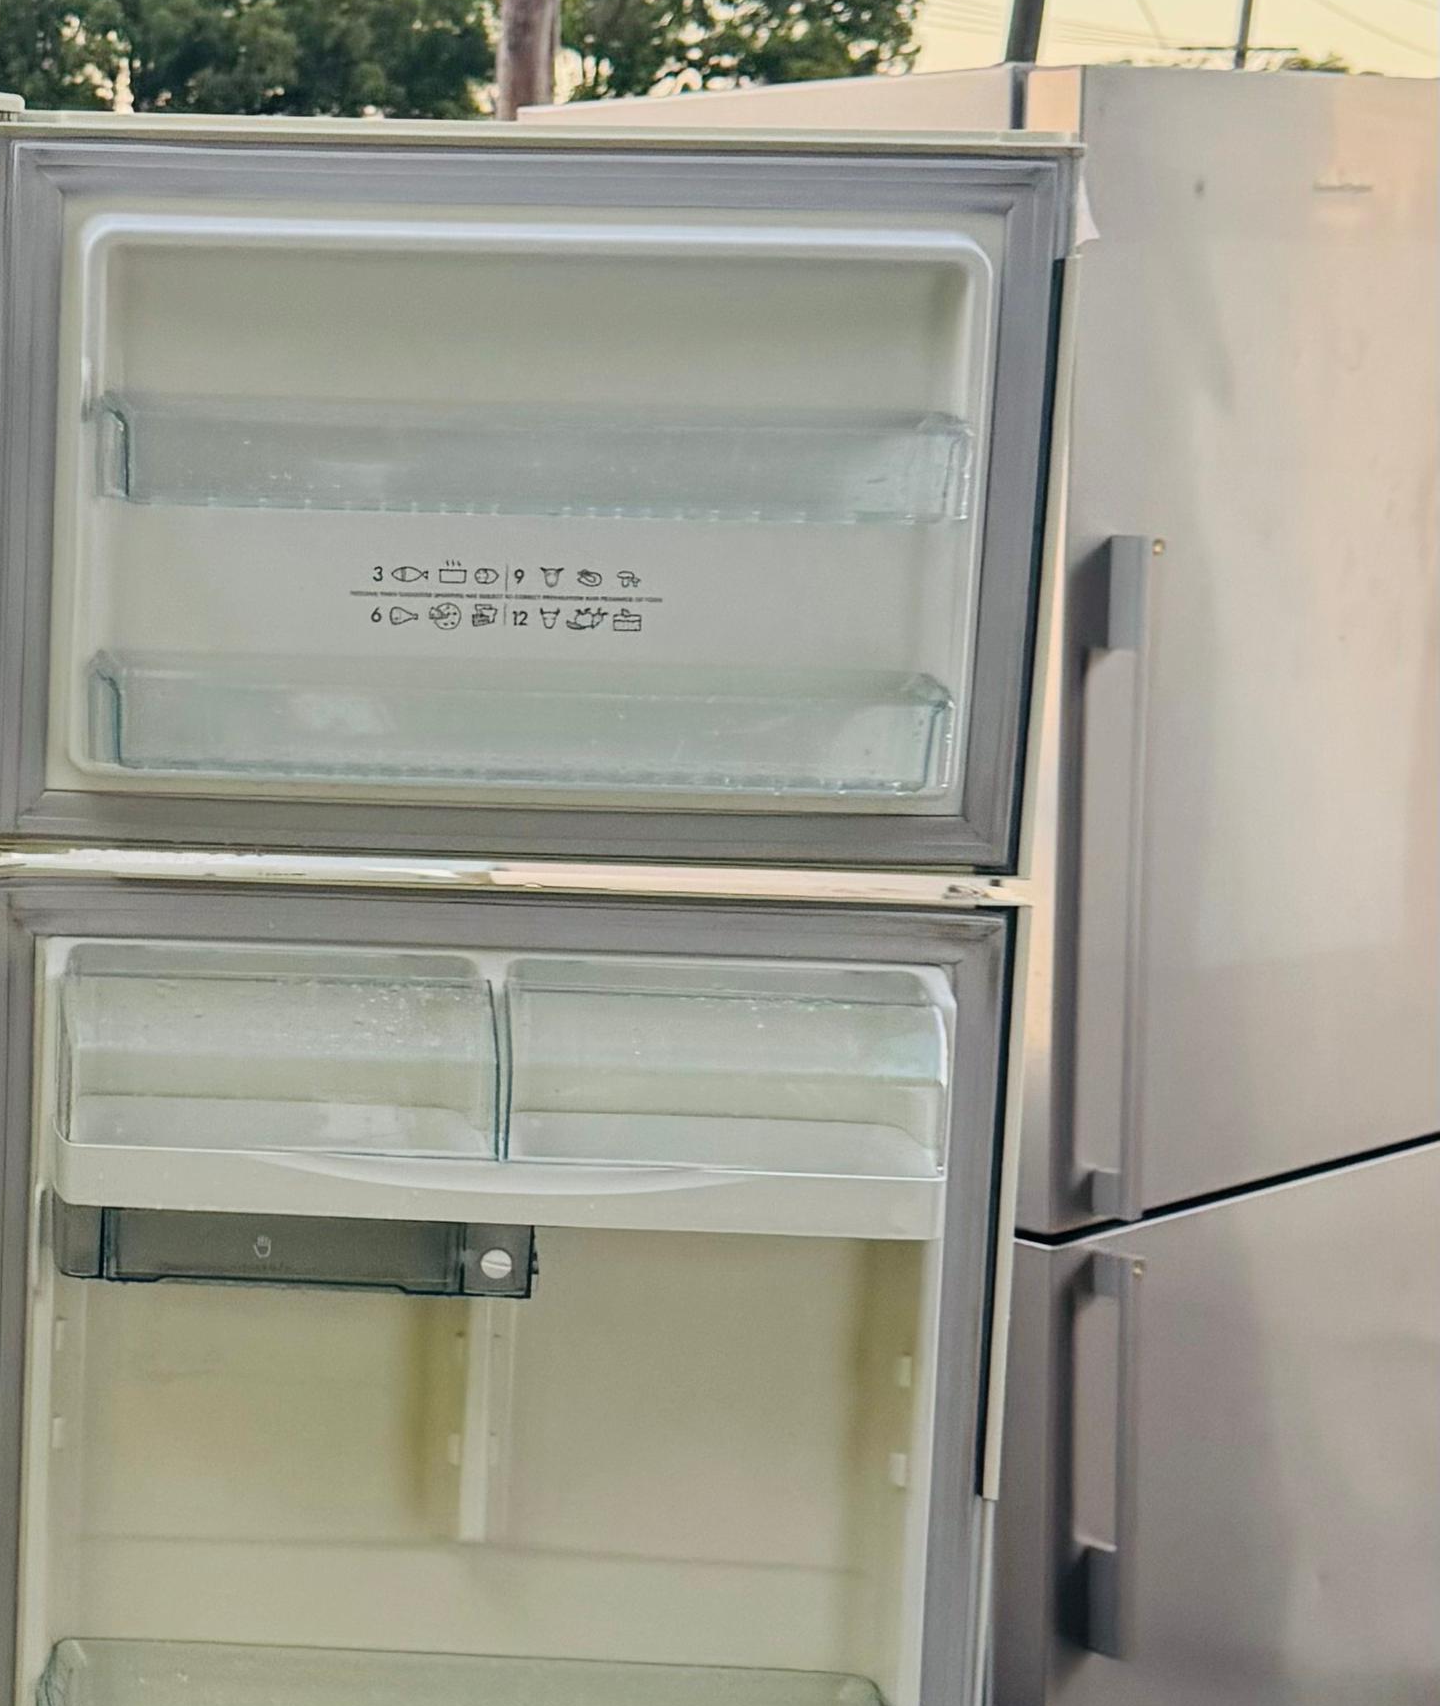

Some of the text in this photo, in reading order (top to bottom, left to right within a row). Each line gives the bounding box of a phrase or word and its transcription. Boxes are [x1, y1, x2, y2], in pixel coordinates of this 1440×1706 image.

[372, 565, 384, 582] 3
[514, 568, 525, 584] 9
[370, 606, 382, 623] 6
[512, 610, 528, 626] 12
